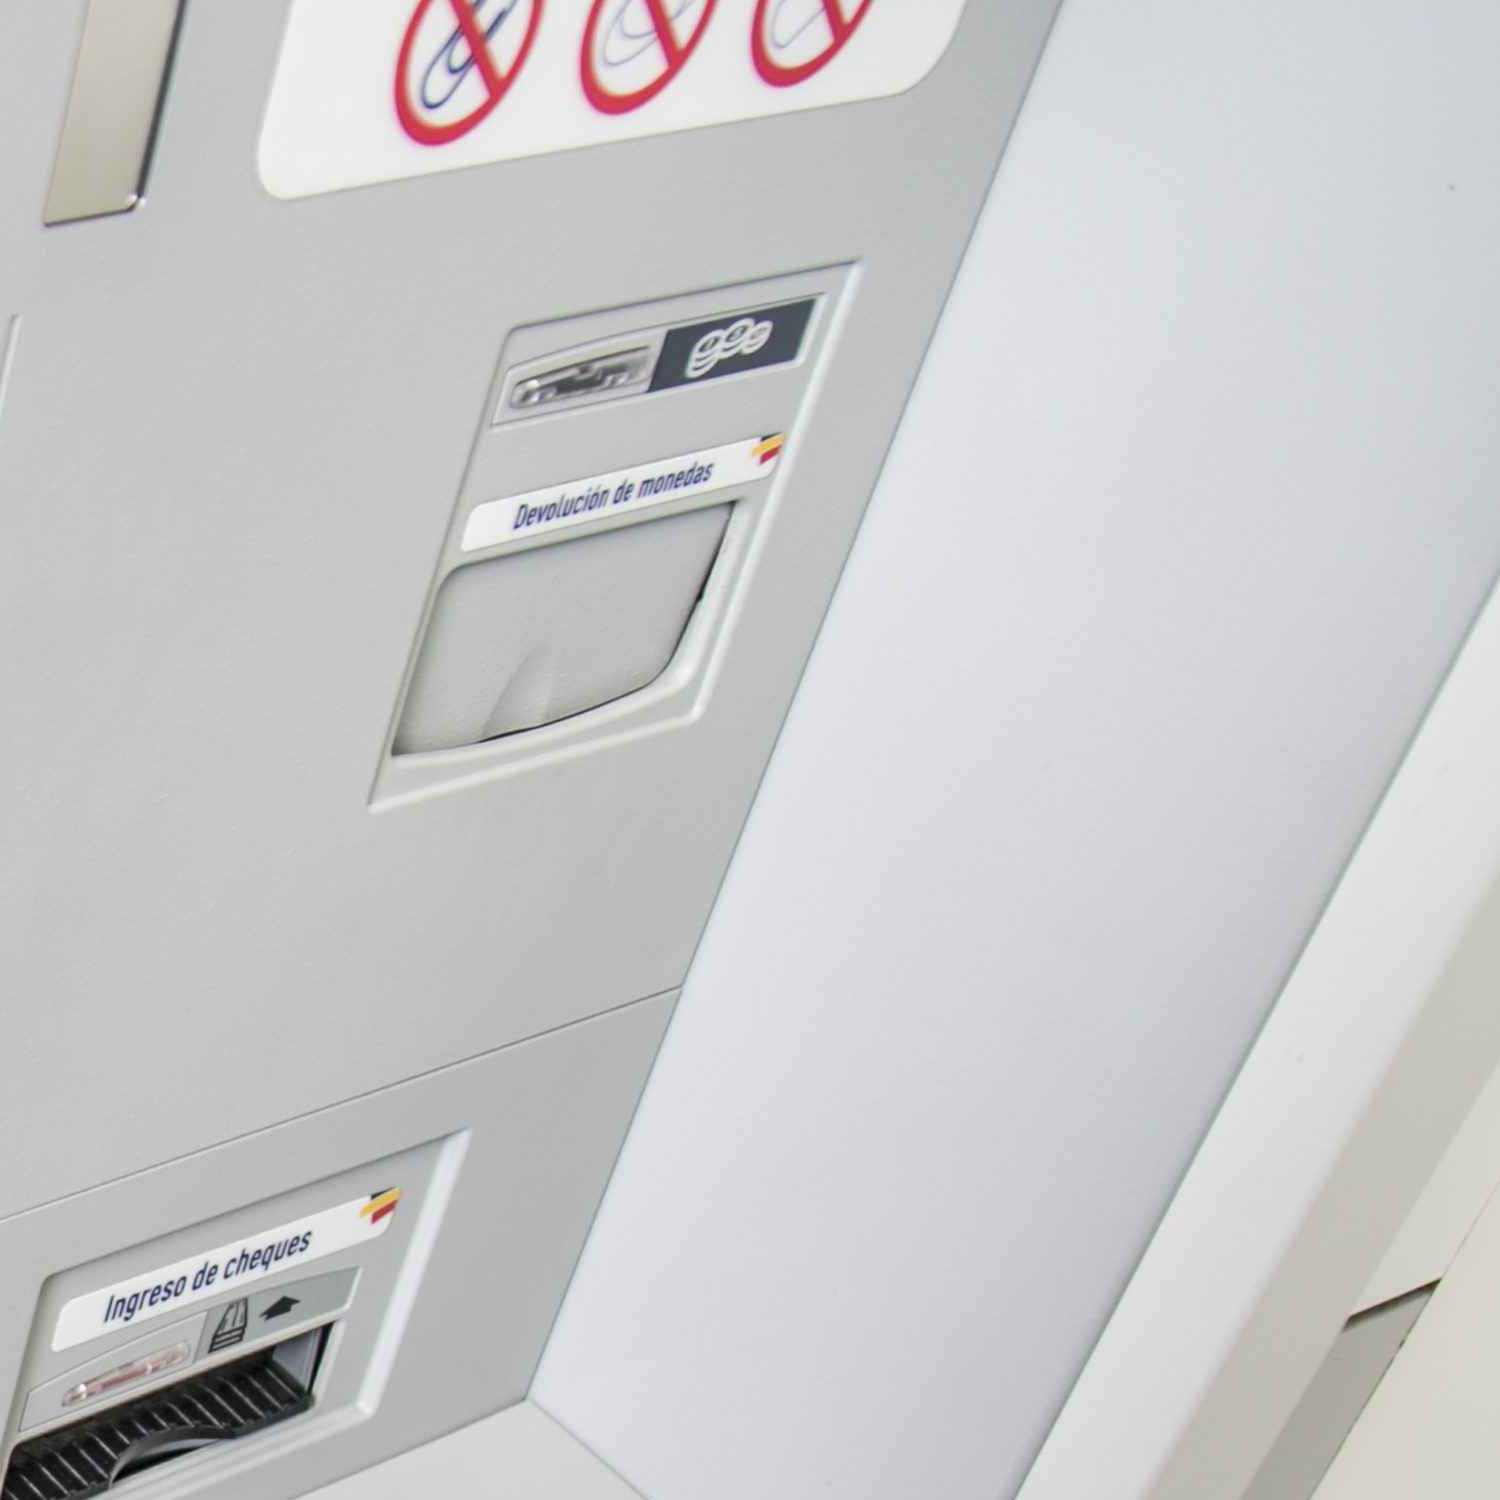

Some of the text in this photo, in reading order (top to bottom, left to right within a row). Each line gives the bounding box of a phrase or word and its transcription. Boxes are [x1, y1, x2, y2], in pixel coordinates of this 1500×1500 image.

[513, 459, 715, 531] Devolución de monedas
[103, 1229, 313, 1325] Ingreso de cheques
